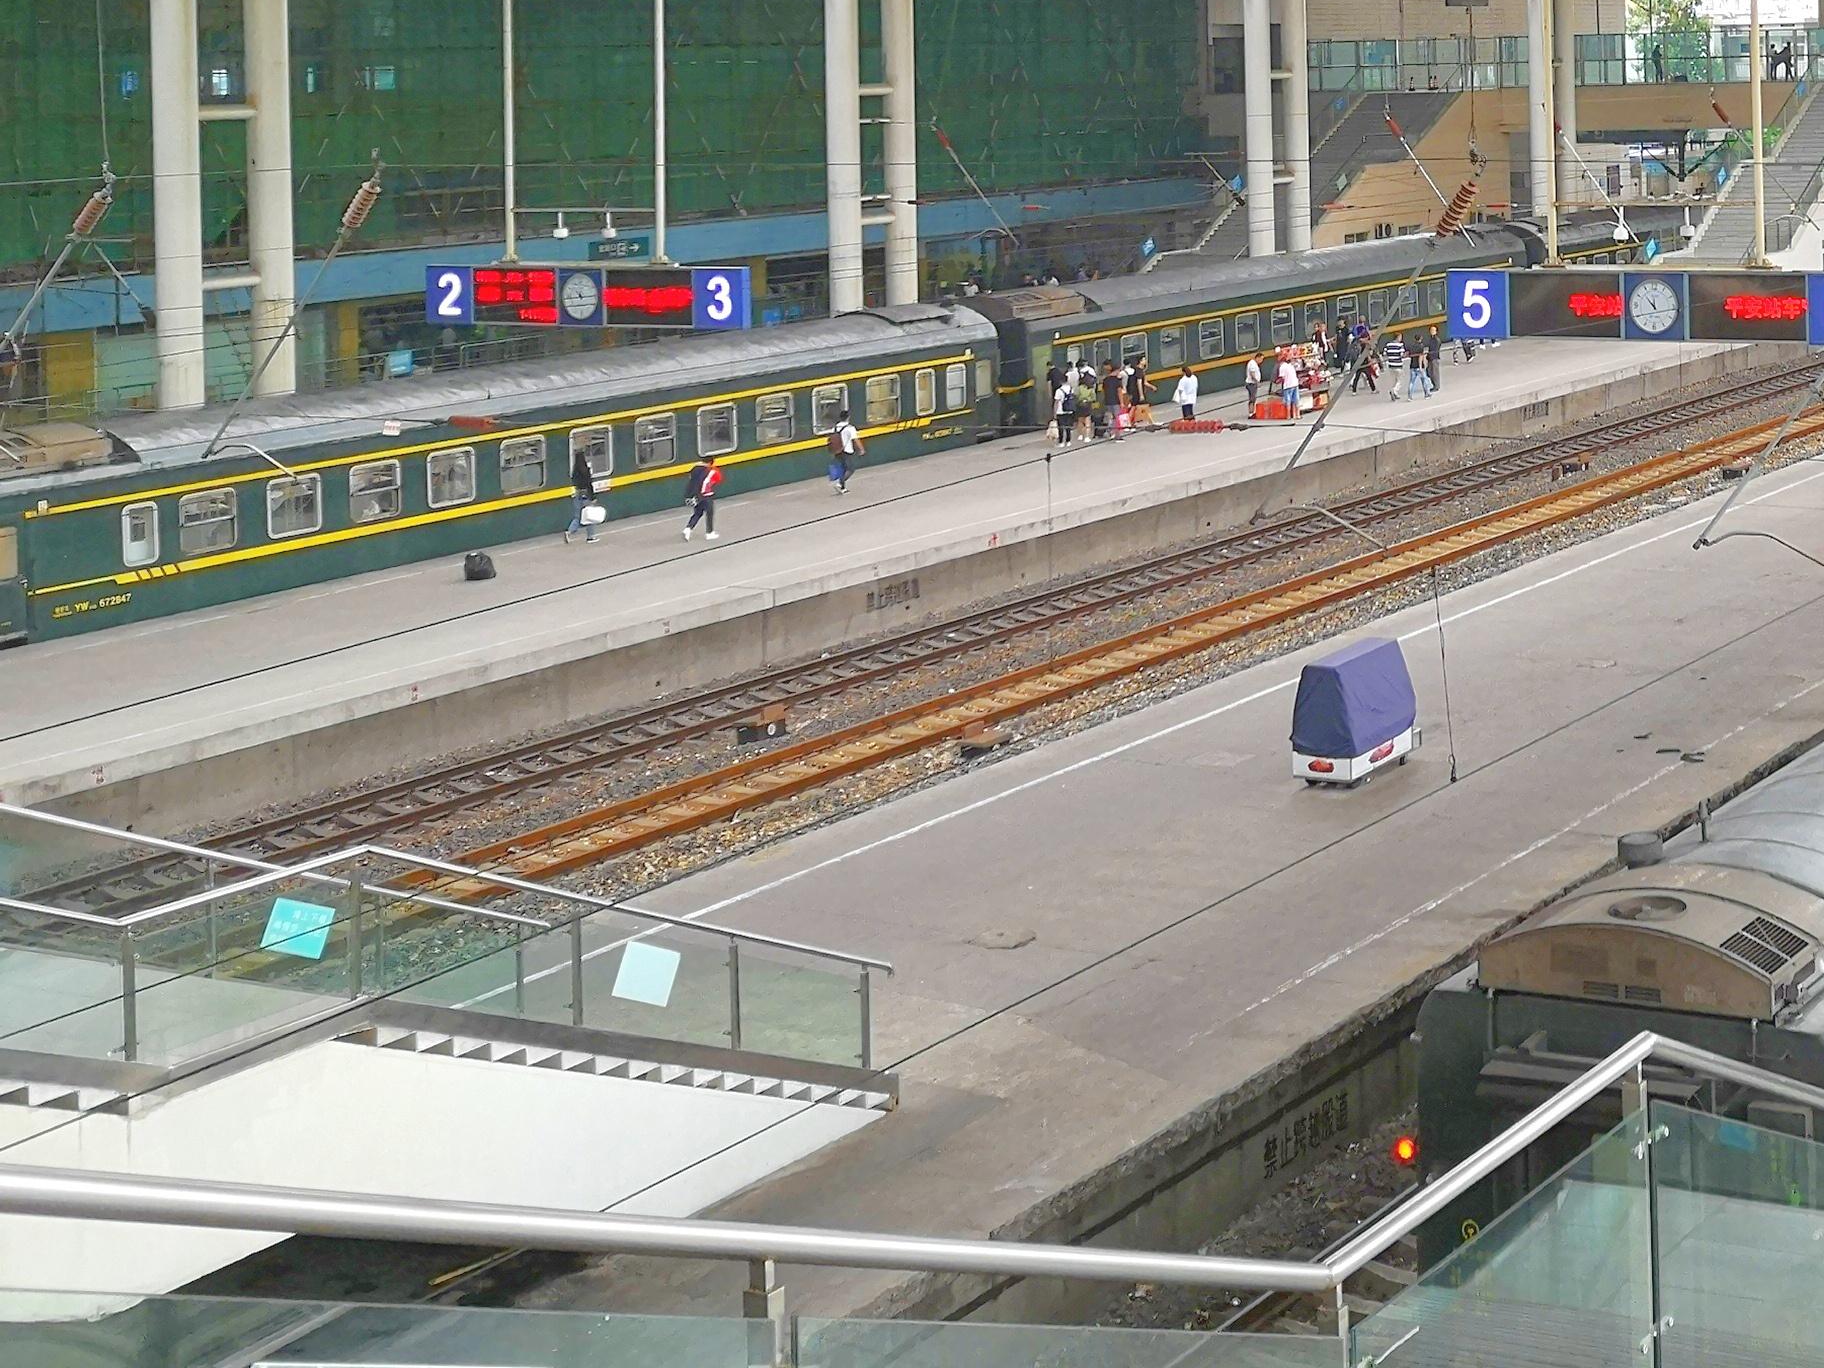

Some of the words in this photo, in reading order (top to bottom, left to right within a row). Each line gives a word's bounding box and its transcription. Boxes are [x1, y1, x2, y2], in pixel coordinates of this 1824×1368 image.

[437, 273, 462, 316] 2
[706, 276, 732, 321] 3
[1462, 280, 1491, 329] 5
